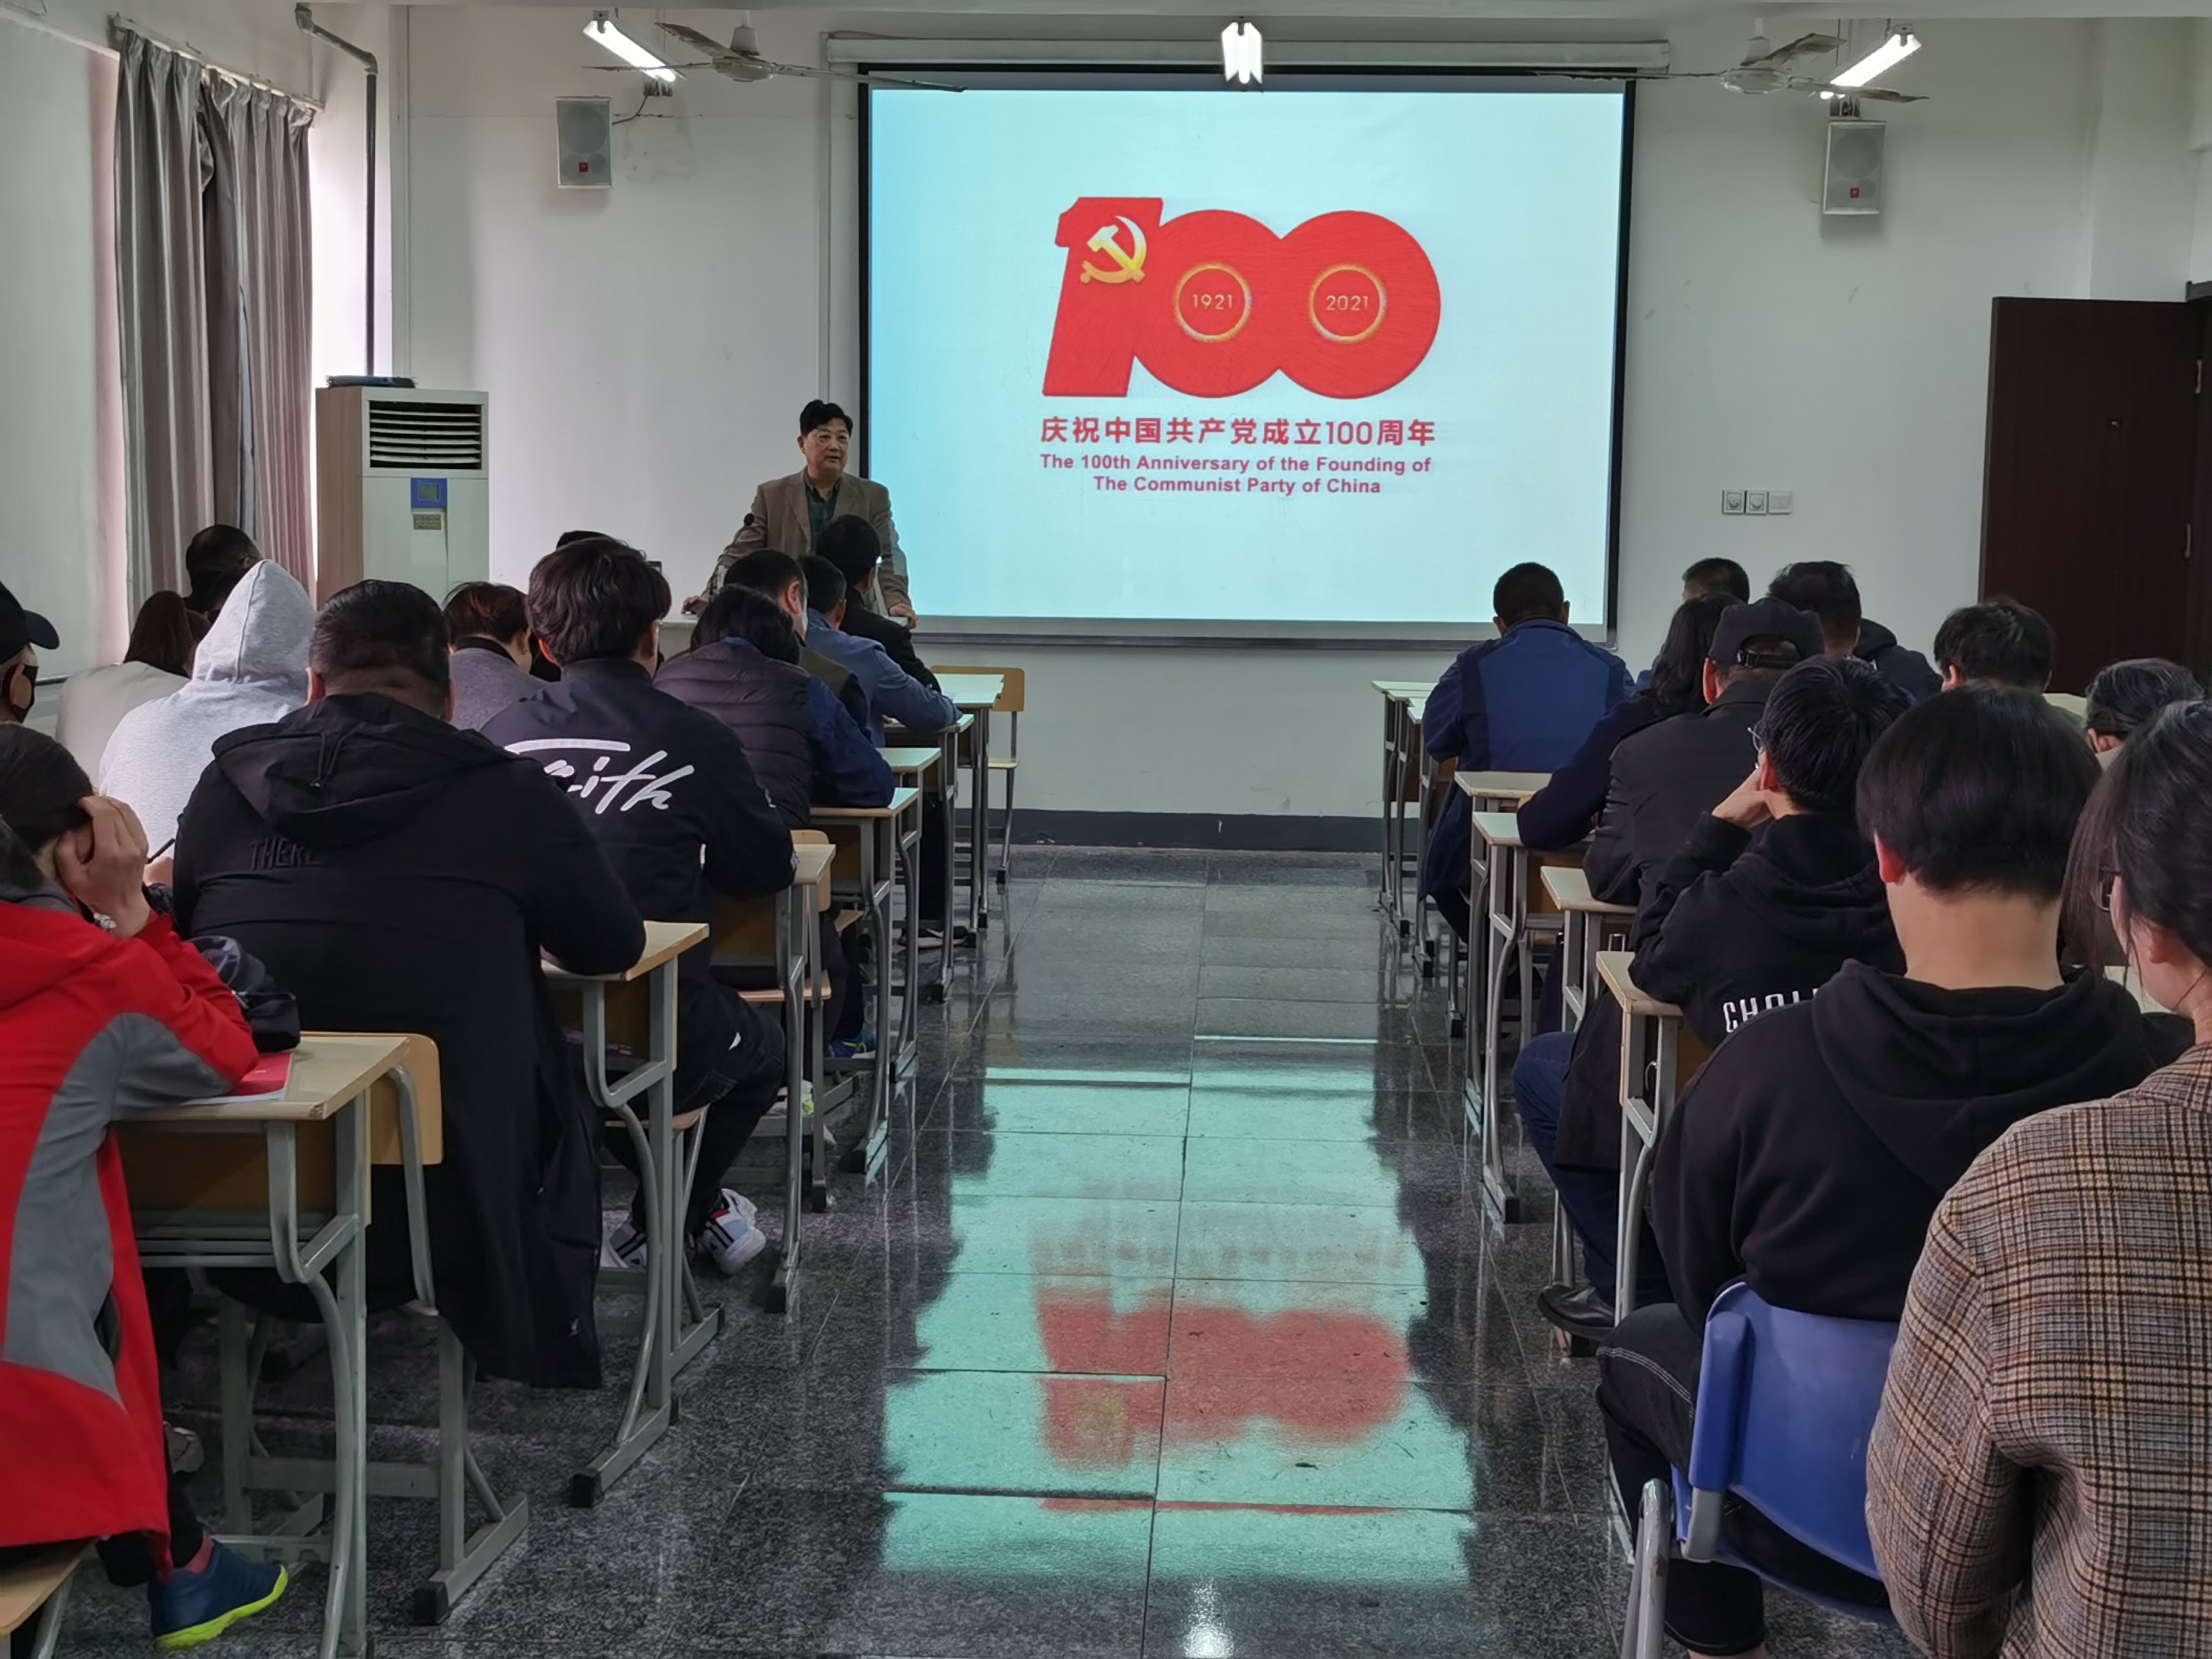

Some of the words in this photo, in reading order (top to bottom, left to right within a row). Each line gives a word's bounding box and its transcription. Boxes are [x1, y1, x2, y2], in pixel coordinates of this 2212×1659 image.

[1192, 293, 1233, 310] 1921
[1326, 295, 1369, 311] 2021
[1041, 416, 1435, 446] 庆祝中国共产党成立100周年
[1040, 454, 1074, 469] The
[1081, 454, 1130, 469] 100th
[1136, 455, 1249, 474] Anniversary
[1256, 456, 1275, 471] of
[1281, 457, 1310, 471] the
[1316, 457, 1406, 476] Founding
[1412, 457, 1432, 472] of
[1093, 476, 1127, 491] The
[1134, 476, 1241, 492] Communist
[1247, 477, 1296, 496] Party
[1302, 478, 1321, 492] of
[1327, 478, 1381, 493] China
[504, 738, 695, 815] ith
